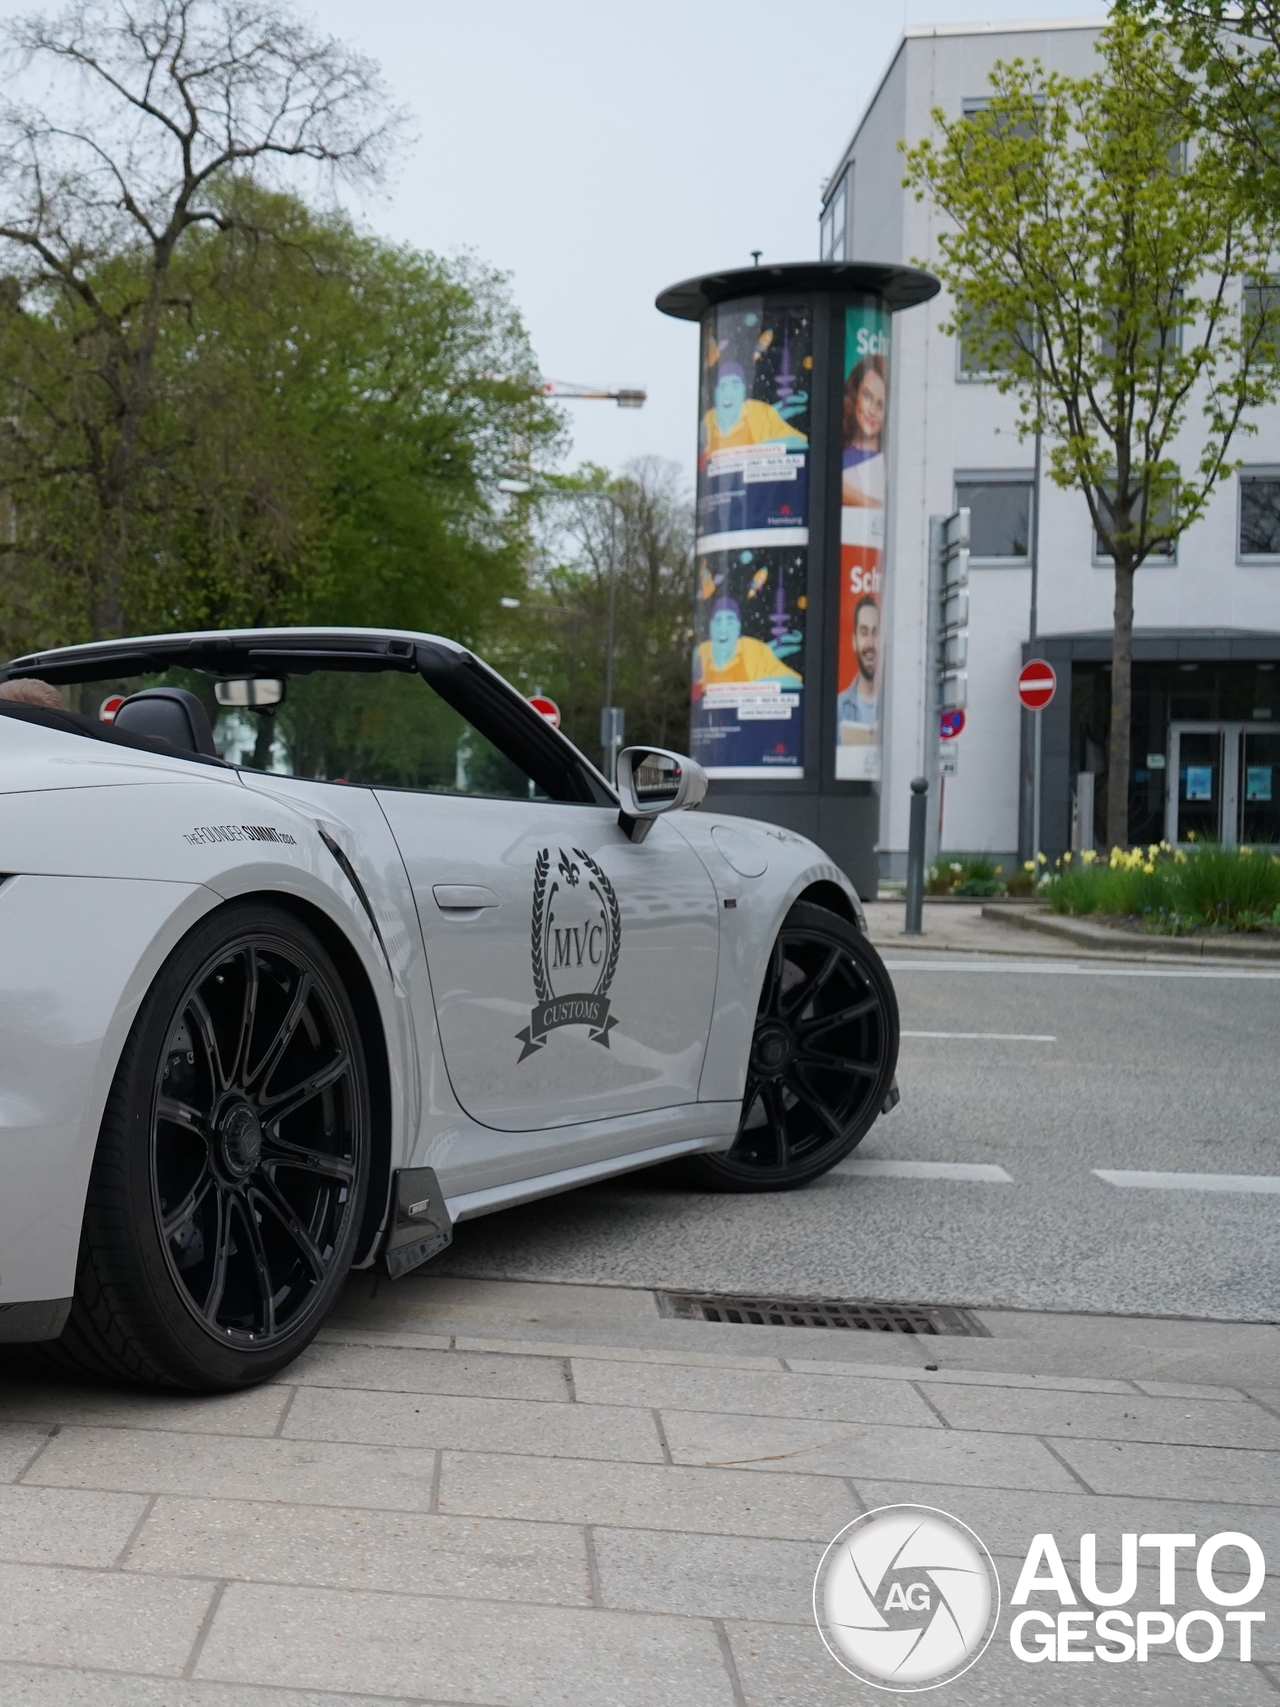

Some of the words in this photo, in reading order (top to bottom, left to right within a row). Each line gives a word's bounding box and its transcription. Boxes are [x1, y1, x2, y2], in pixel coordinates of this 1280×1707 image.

[194, 826, 248, 843] FOUNDER
[241, 826, 283, 842] SUMMIT
[552, 919, 603, 970] MVC
[543, 1000, 601, 1027] CUSTOMS
